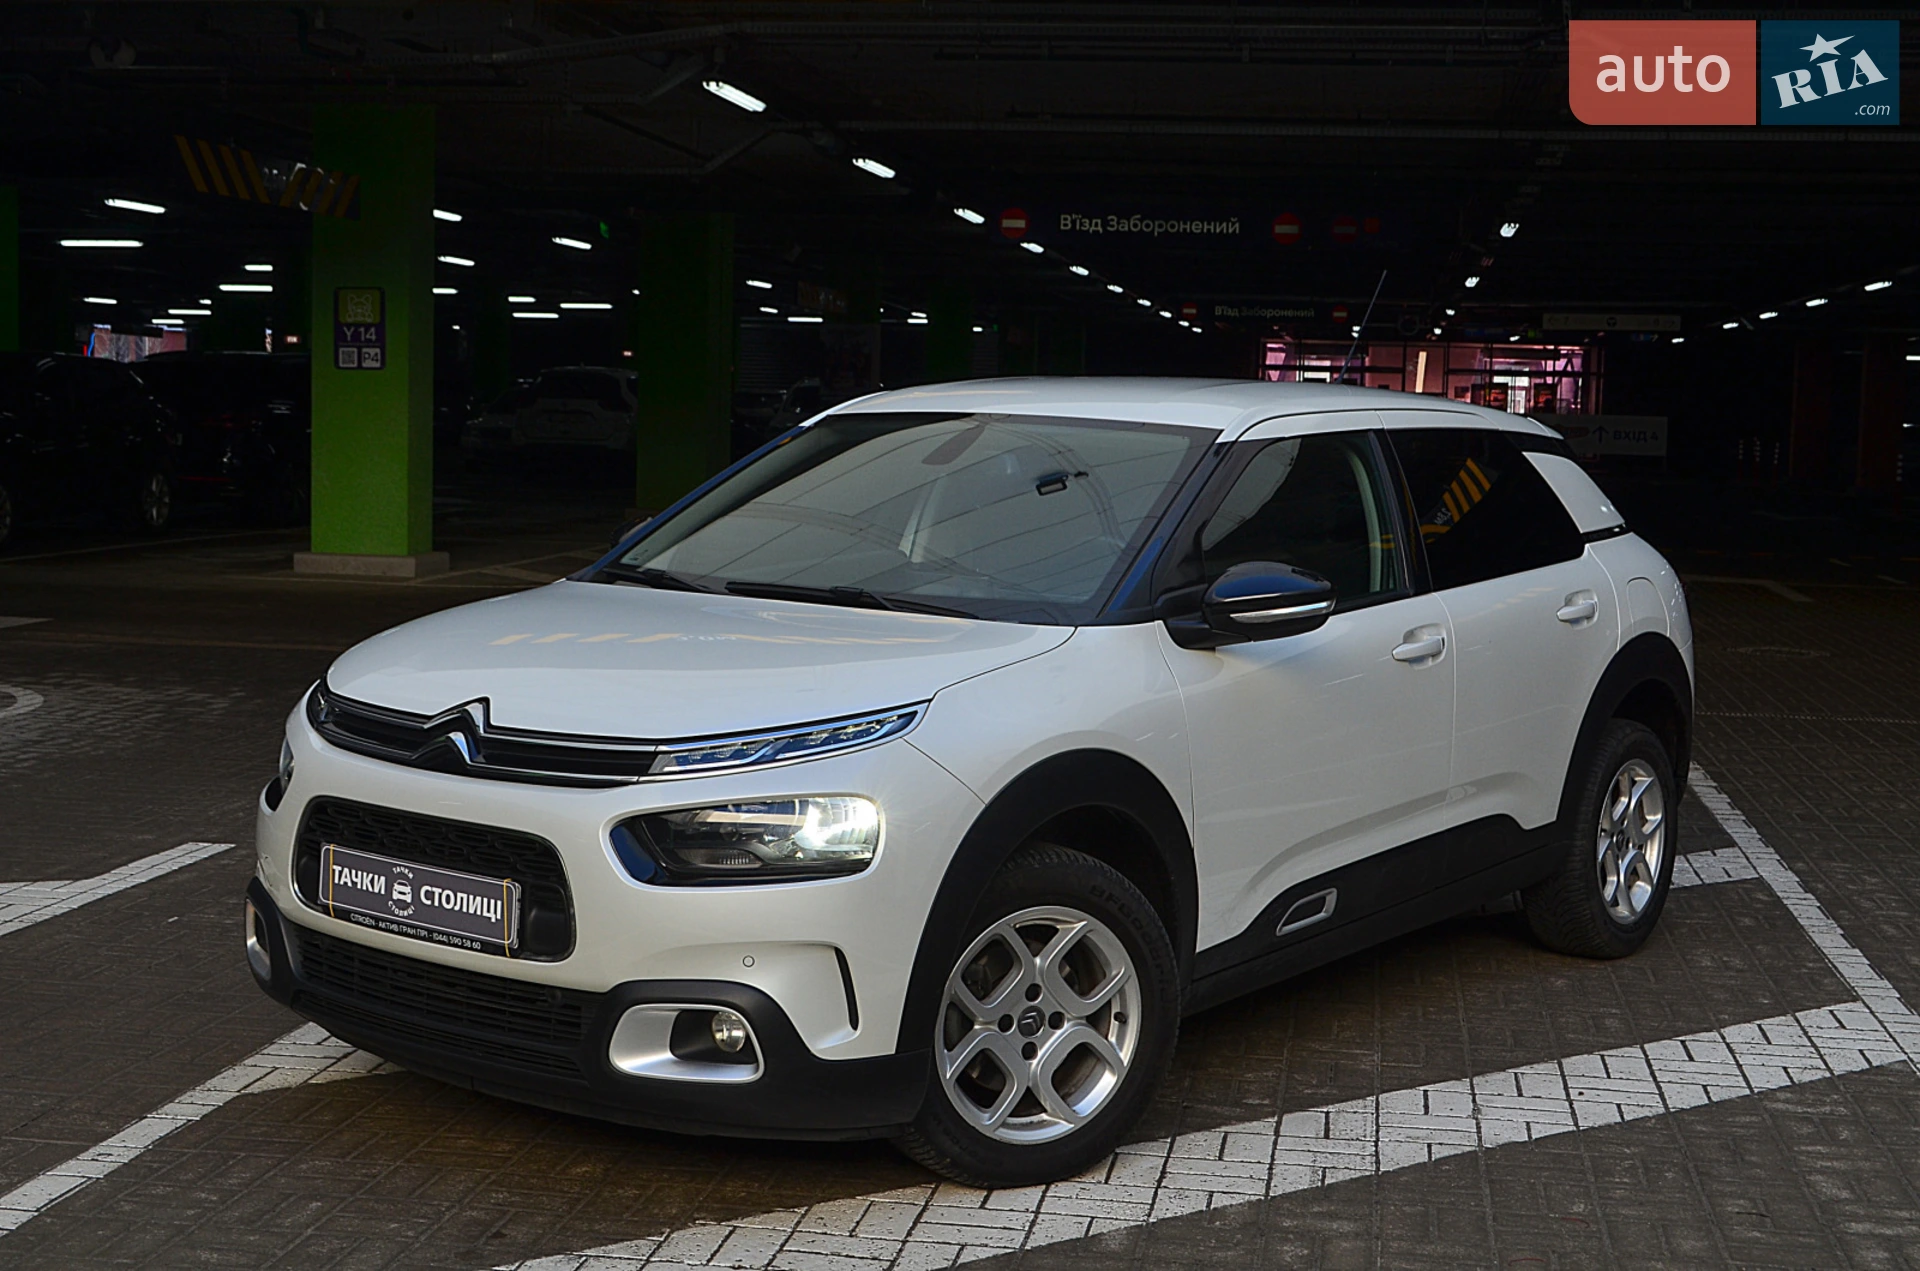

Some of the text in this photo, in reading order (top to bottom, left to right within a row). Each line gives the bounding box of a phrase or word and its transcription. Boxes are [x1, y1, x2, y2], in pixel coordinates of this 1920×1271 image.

[1107, 214, 1240, 237] Заборонений
[343, 326, 377, 342] Y 14
[363, 351, 379, 363] P4
[1613, 429, 1648, 443] ВХІД
[392, 866, 414, 879] ТАЧКИ
[332, 864, 502, 923] ТАЧКИ СТОЛИЦІ
